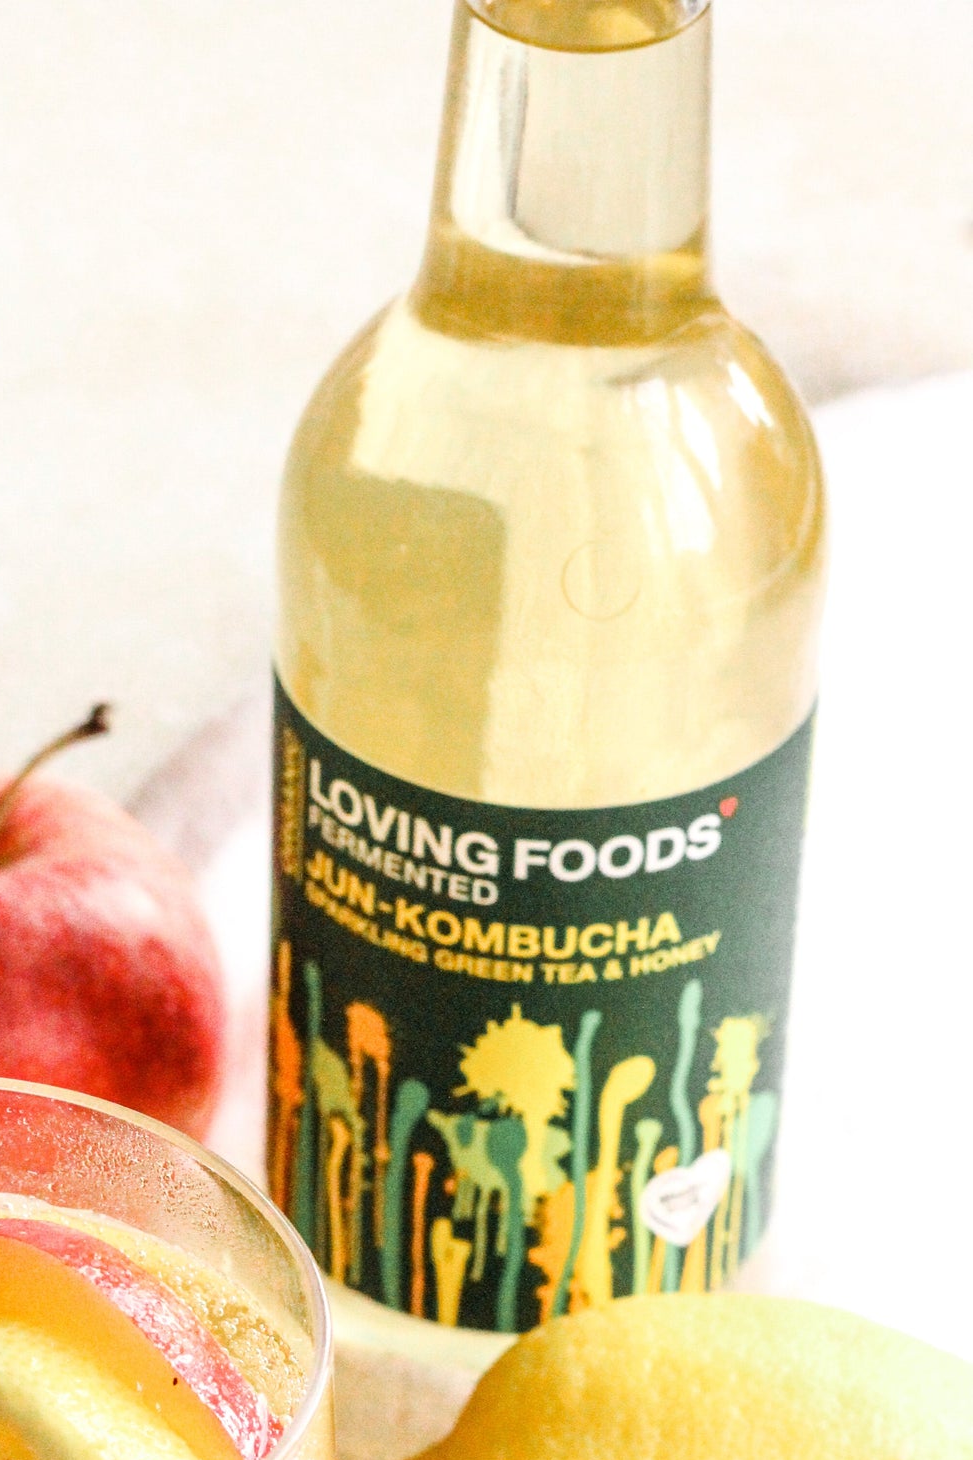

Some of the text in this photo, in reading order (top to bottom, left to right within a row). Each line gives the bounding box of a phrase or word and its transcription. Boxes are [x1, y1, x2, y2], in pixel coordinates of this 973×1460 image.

[308, 805, 500, 907] FERMENTED
[310, 759, 500, 877] LOVING
[514, 813, 723, 882] FOODS
[307, 851, 683, 960] JUN-KOMBUCHA
[434, 948, 534, 984] GREEN
[541, 961, 598, 984] TEA
[603, 958, 624, 981] &
[630, 929, 723, 978] HONEY
